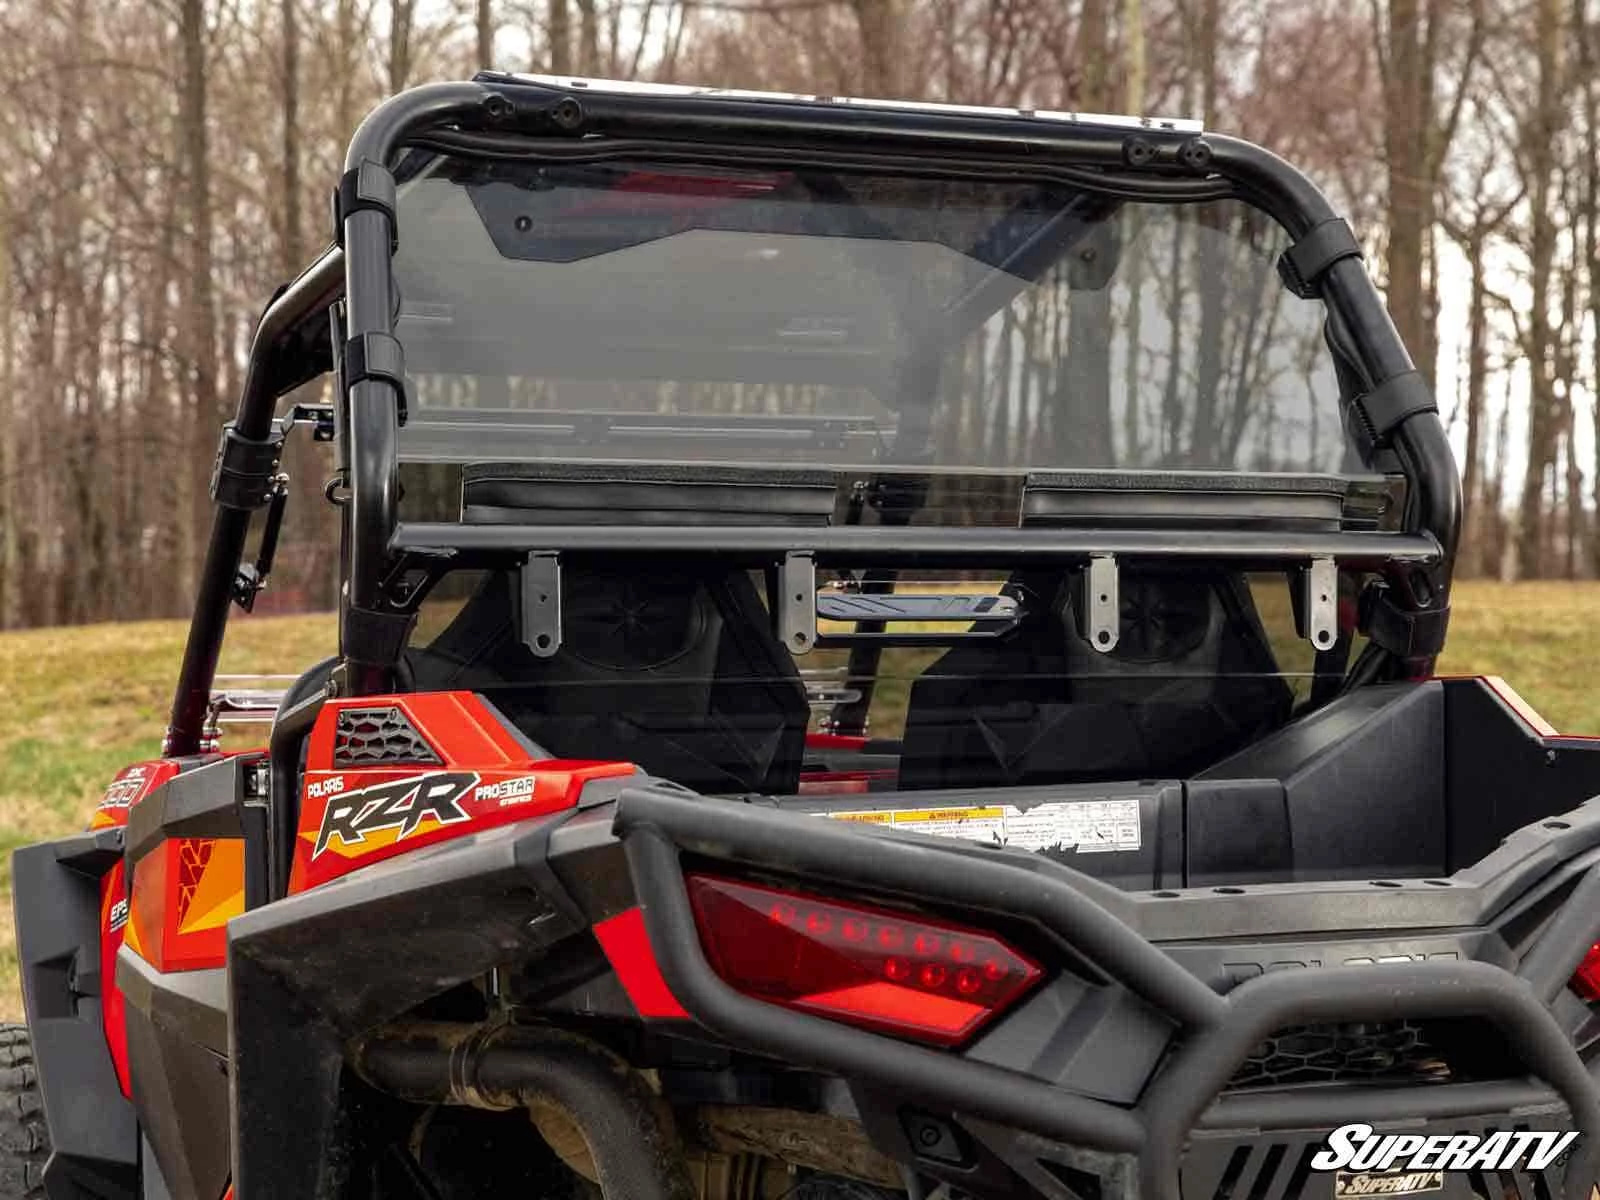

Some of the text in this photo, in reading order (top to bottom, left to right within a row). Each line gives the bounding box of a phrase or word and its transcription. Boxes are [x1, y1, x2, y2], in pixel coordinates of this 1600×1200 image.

[307, 776, 344, 799] POLARIS
[474, 775, 536, 801] PROSTAR
[312, 771, 481, 862] RZR
